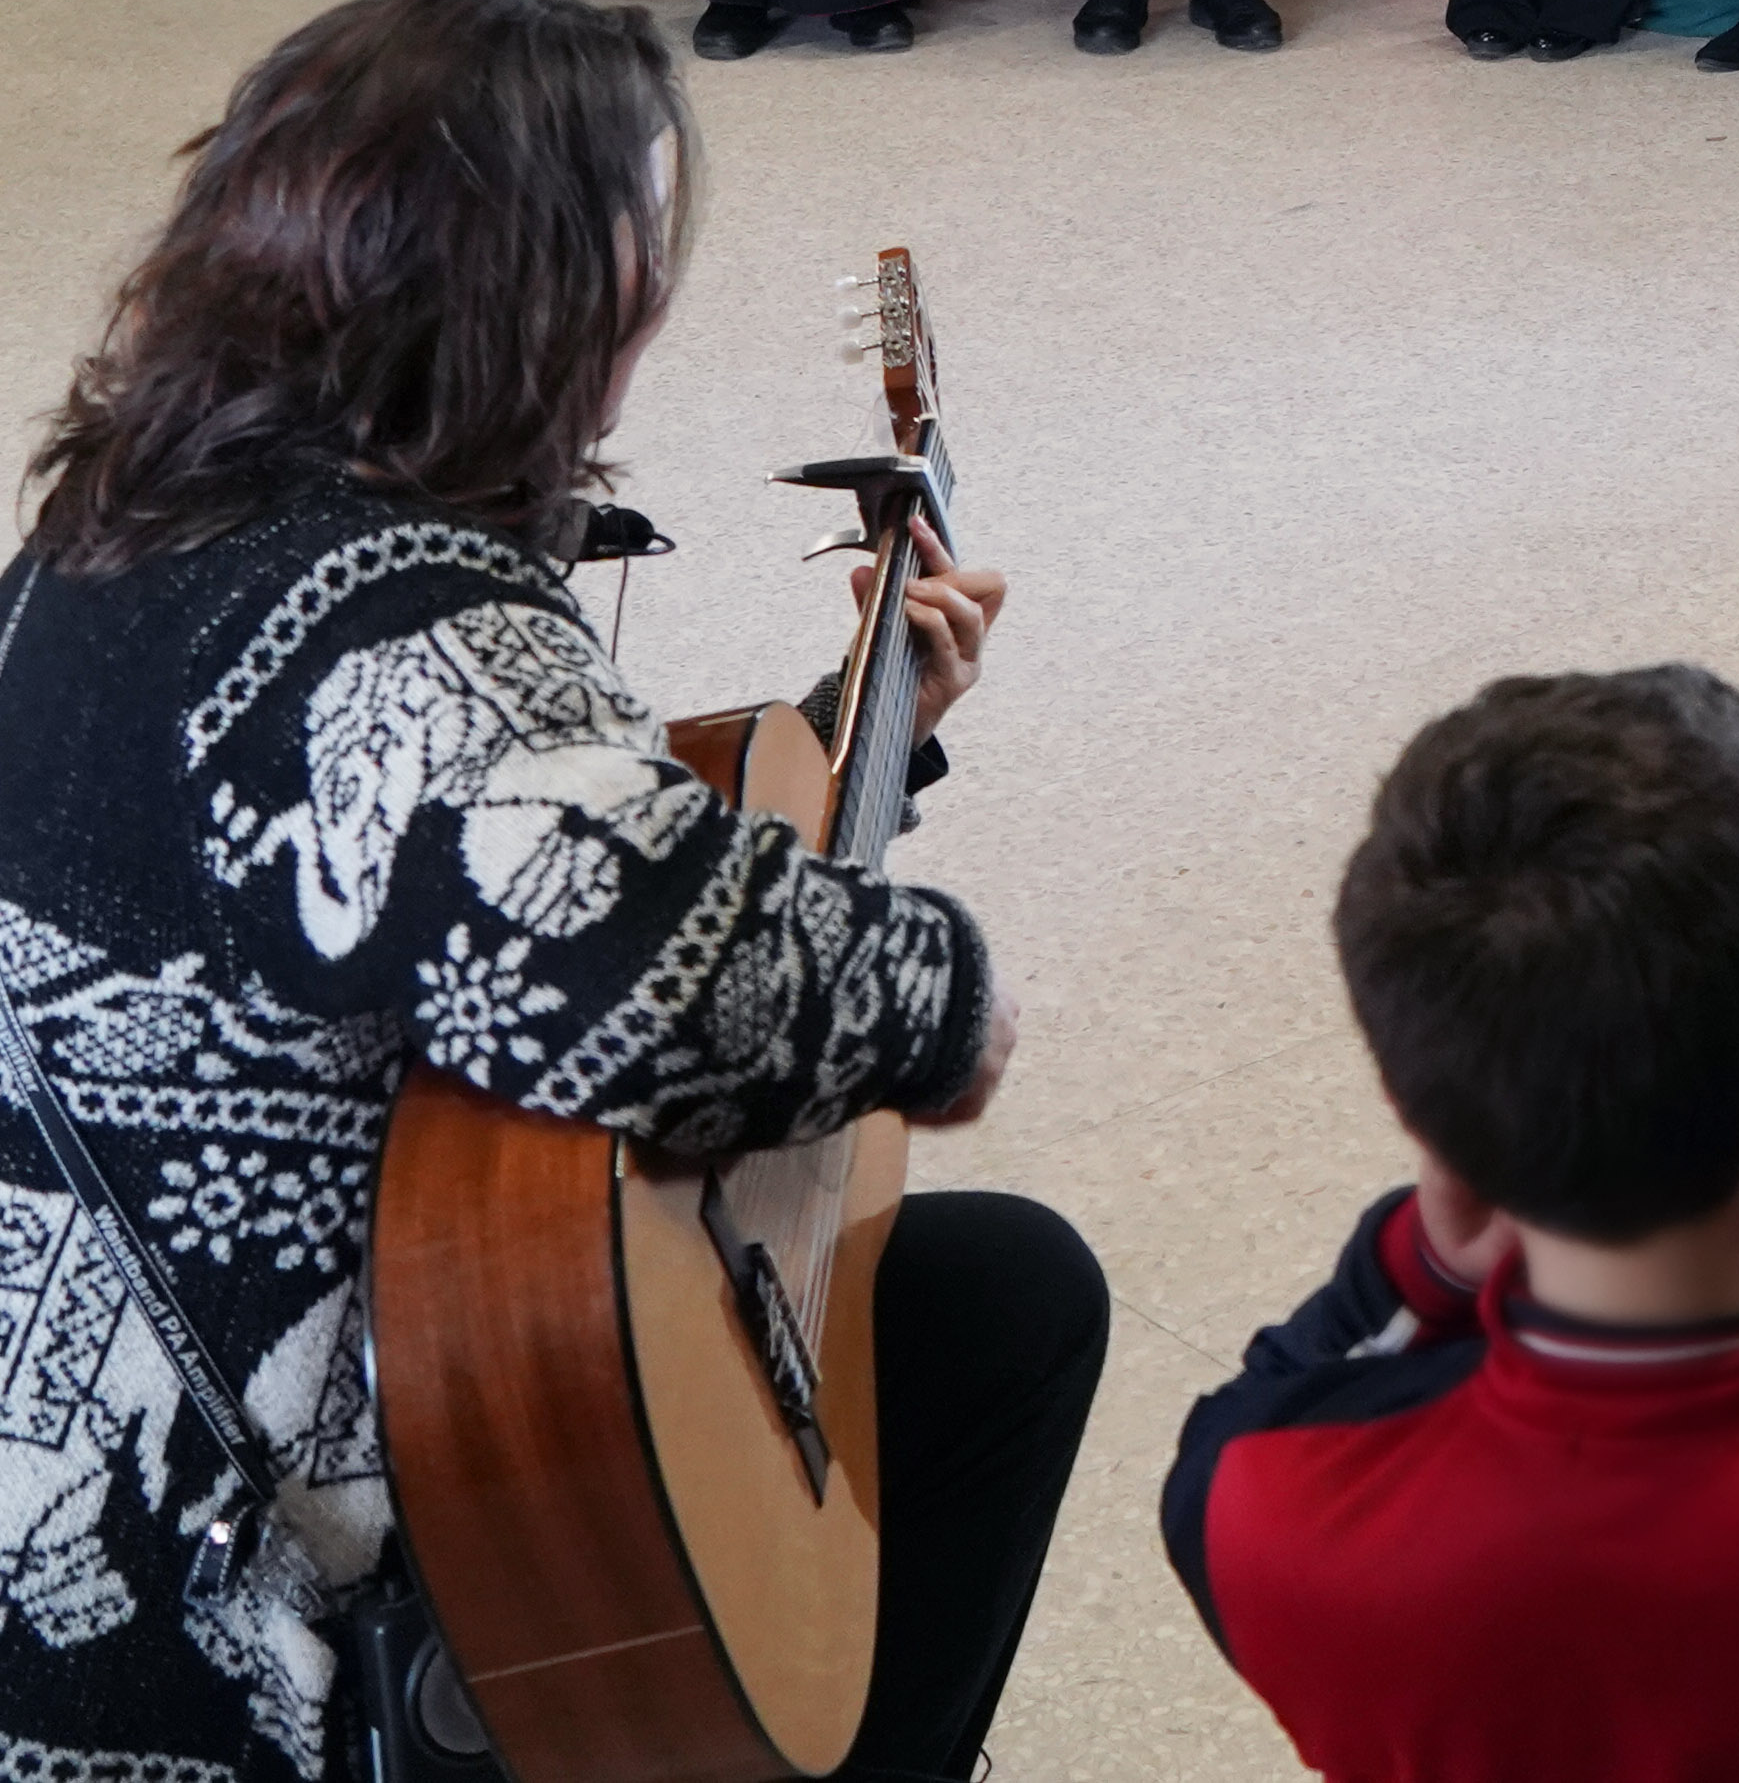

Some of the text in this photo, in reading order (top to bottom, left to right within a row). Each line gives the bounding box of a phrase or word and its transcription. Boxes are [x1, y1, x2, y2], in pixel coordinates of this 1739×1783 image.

[0, 1013, 40, 1092] plifier
[94, 1204, 247, 1445] Waistband PA Amplifier
